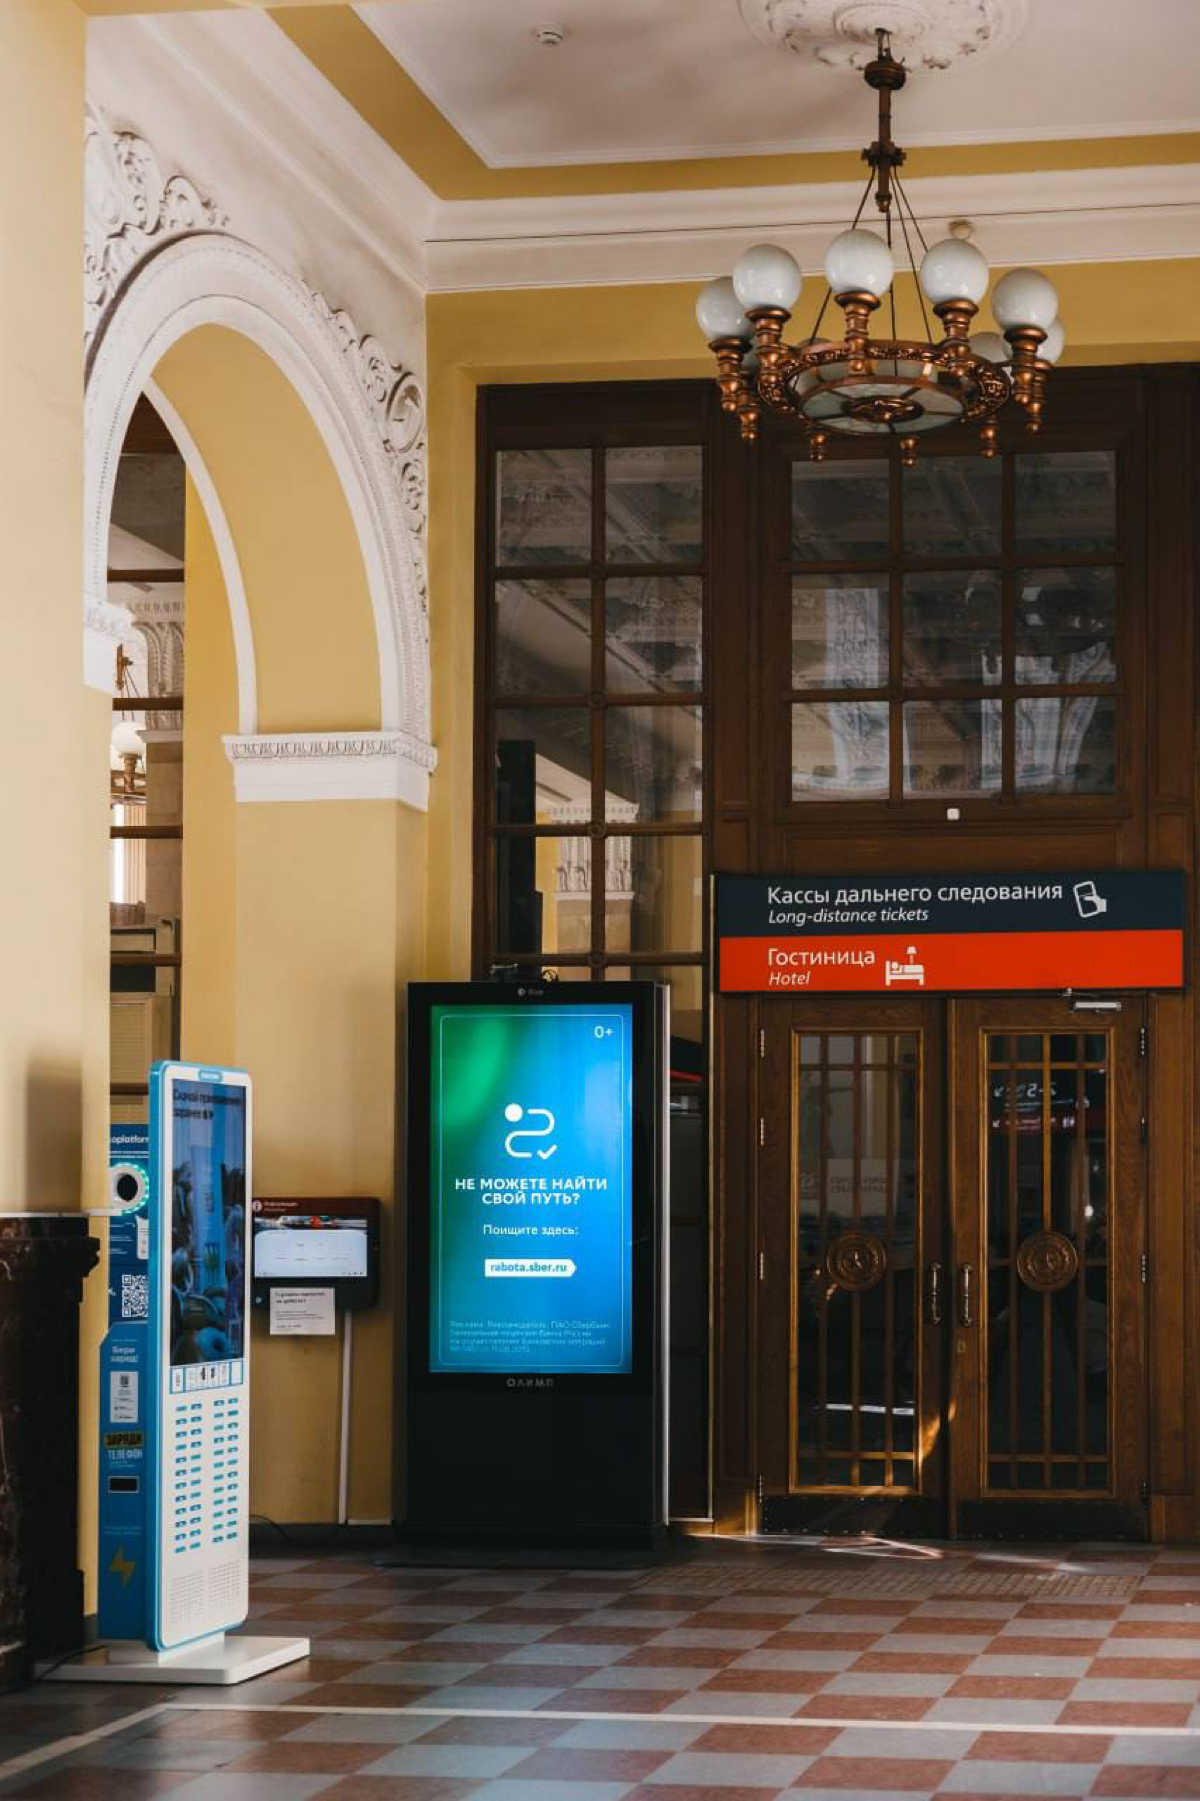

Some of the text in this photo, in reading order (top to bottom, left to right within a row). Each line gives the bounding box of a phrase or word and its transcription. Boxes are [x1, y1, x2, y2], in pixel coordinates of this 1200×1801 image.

[768, 885, 1063, 906] Кассы дальнего следования
[769, 907, 929, 927] Long-distance tickets
[768, 948, 875, 968] Гостиница
[769, 971, 811, 986] Hotel
[594, 1025, 614, 1038] 0+
[455, 1175, 608, 1190] НЕ МОЖЕТЕ НАЙТИ
[482, 1190, 581, 1205] СВОЙ ПУТЬ?
[483, 1224, 579, 1237] Поищите здесь:
[490, 1261, 567, 1273] rabota.sber.ru
